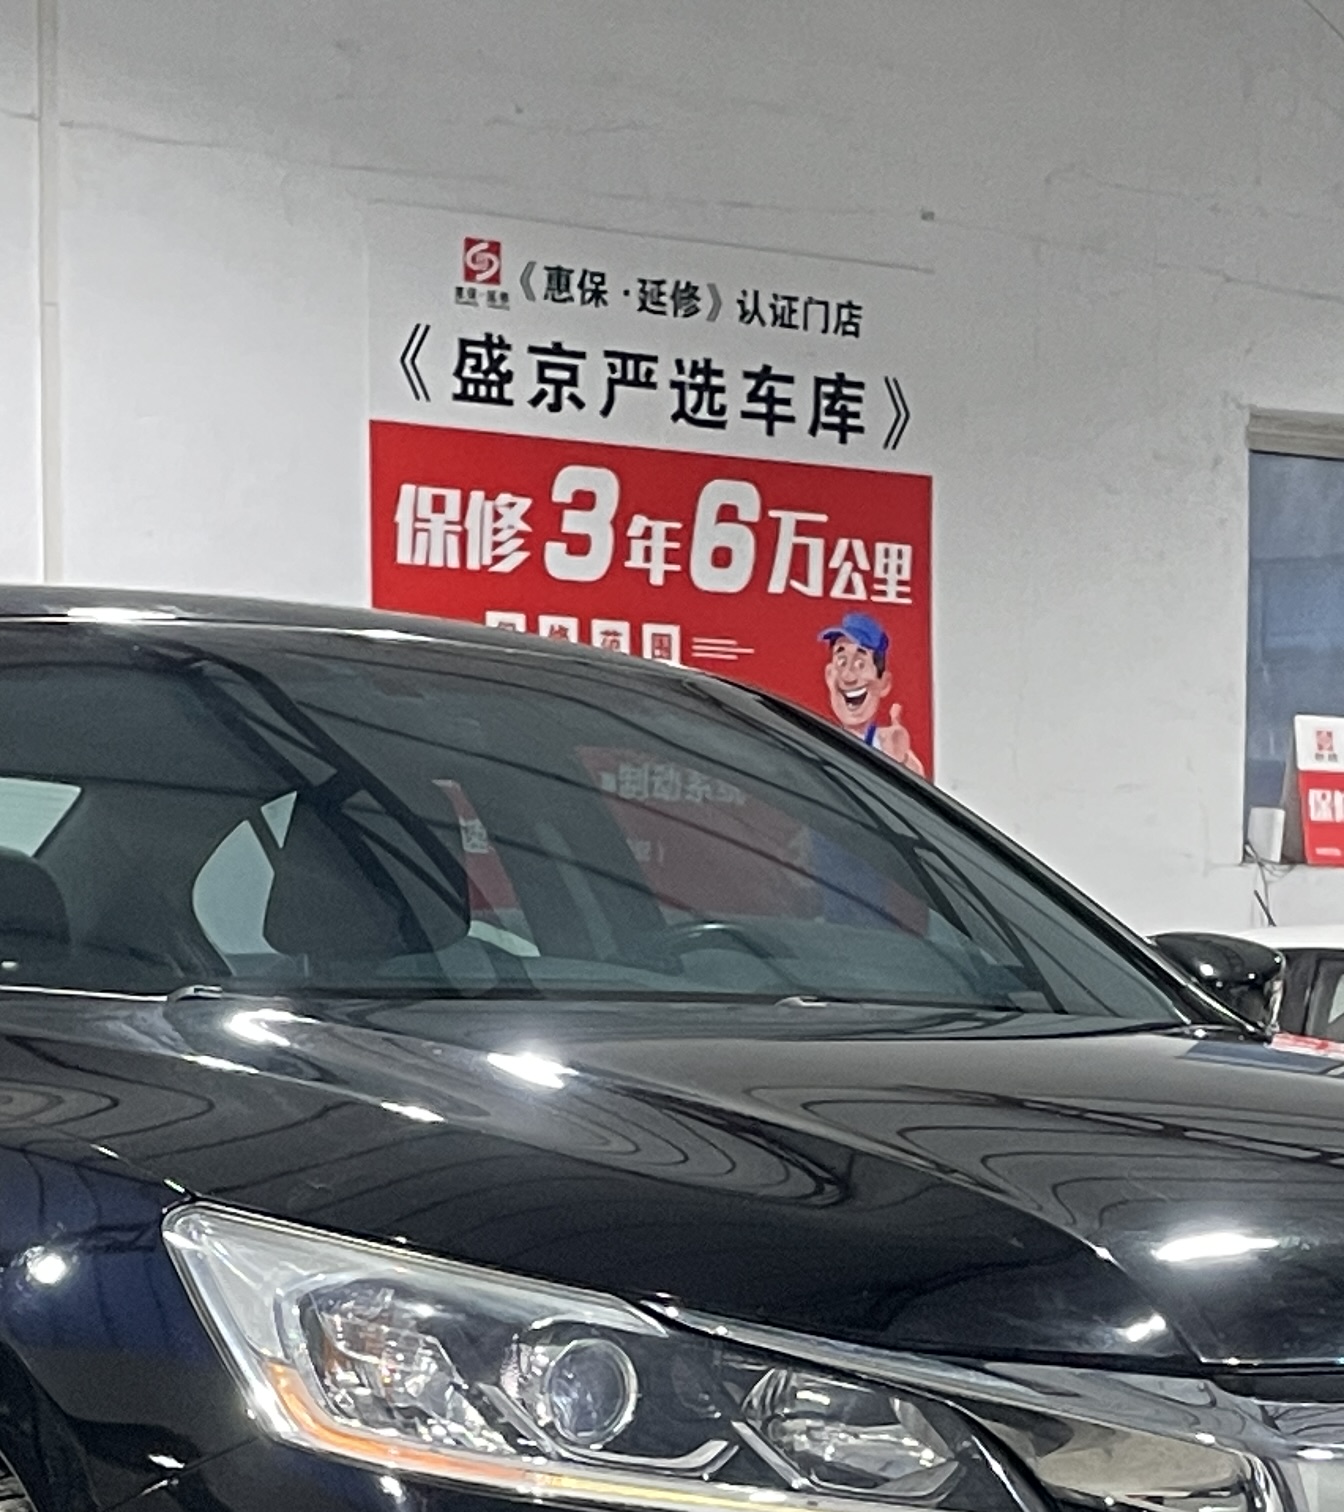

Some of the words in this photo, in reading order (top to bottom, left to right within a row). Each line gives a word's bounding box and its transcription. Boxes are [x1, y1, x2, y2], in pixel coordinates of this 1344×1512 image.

[400, 322, 911, 450] 《盛京严选车库》
[394, 464, 913, 604] 保修3年6万公里
